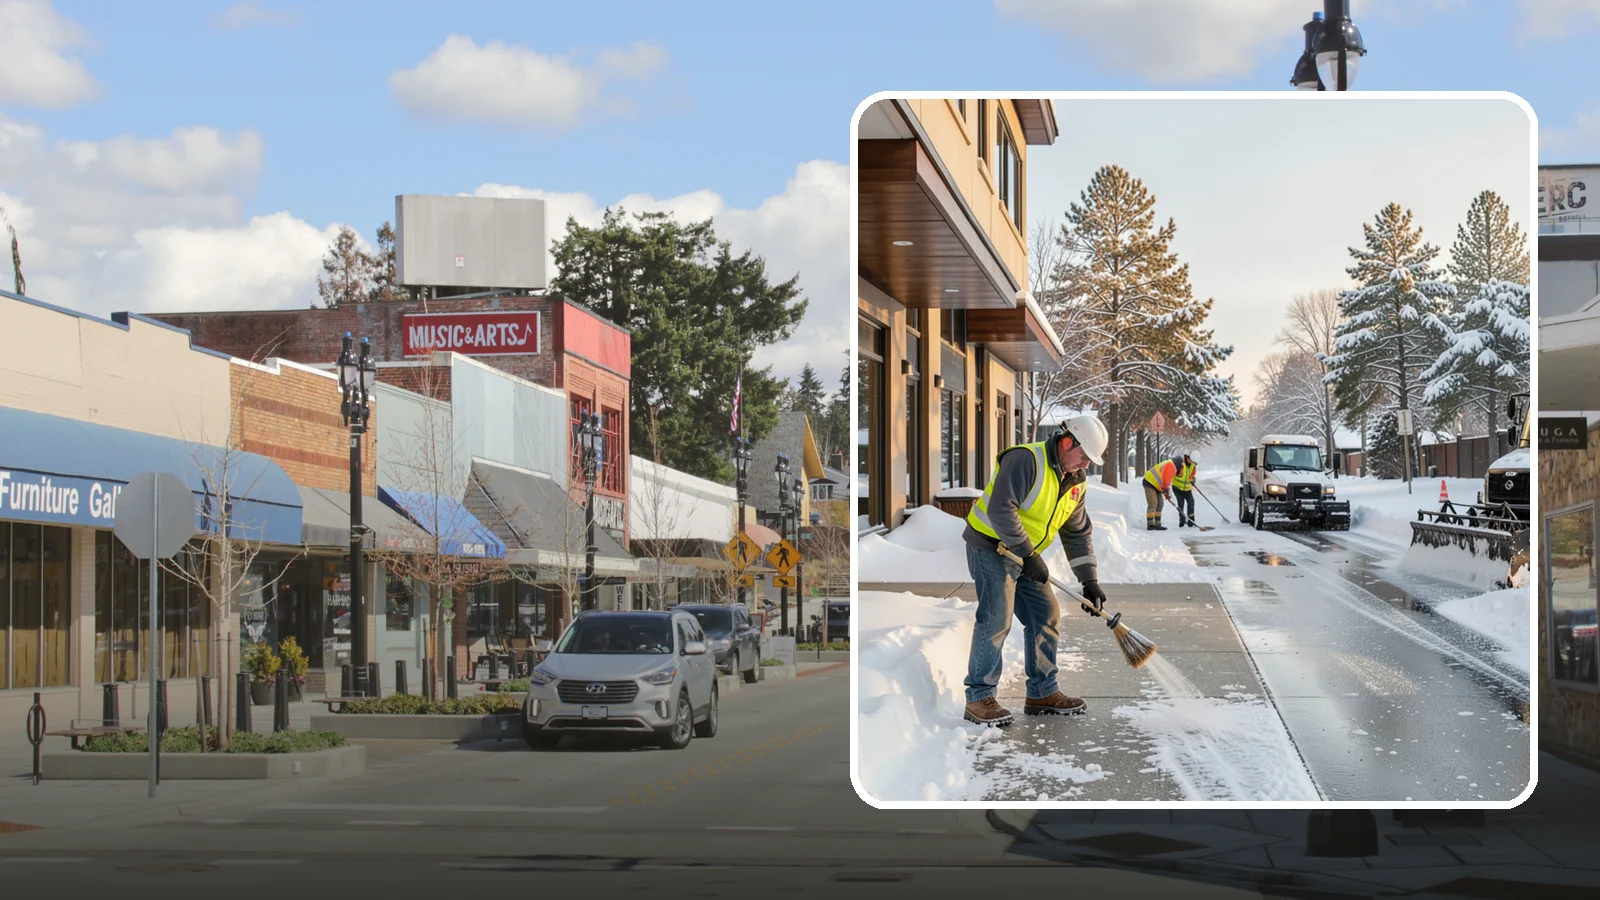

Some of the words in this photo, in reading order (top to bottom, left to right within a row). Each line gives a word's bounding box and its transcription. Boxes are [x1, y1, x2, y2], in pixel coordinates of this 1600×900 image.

[408, 323, 519, 349] MUSIC&ARTS
[0, 471, 79, 516] Furniture
[89, 482, 122, 519] Gal
